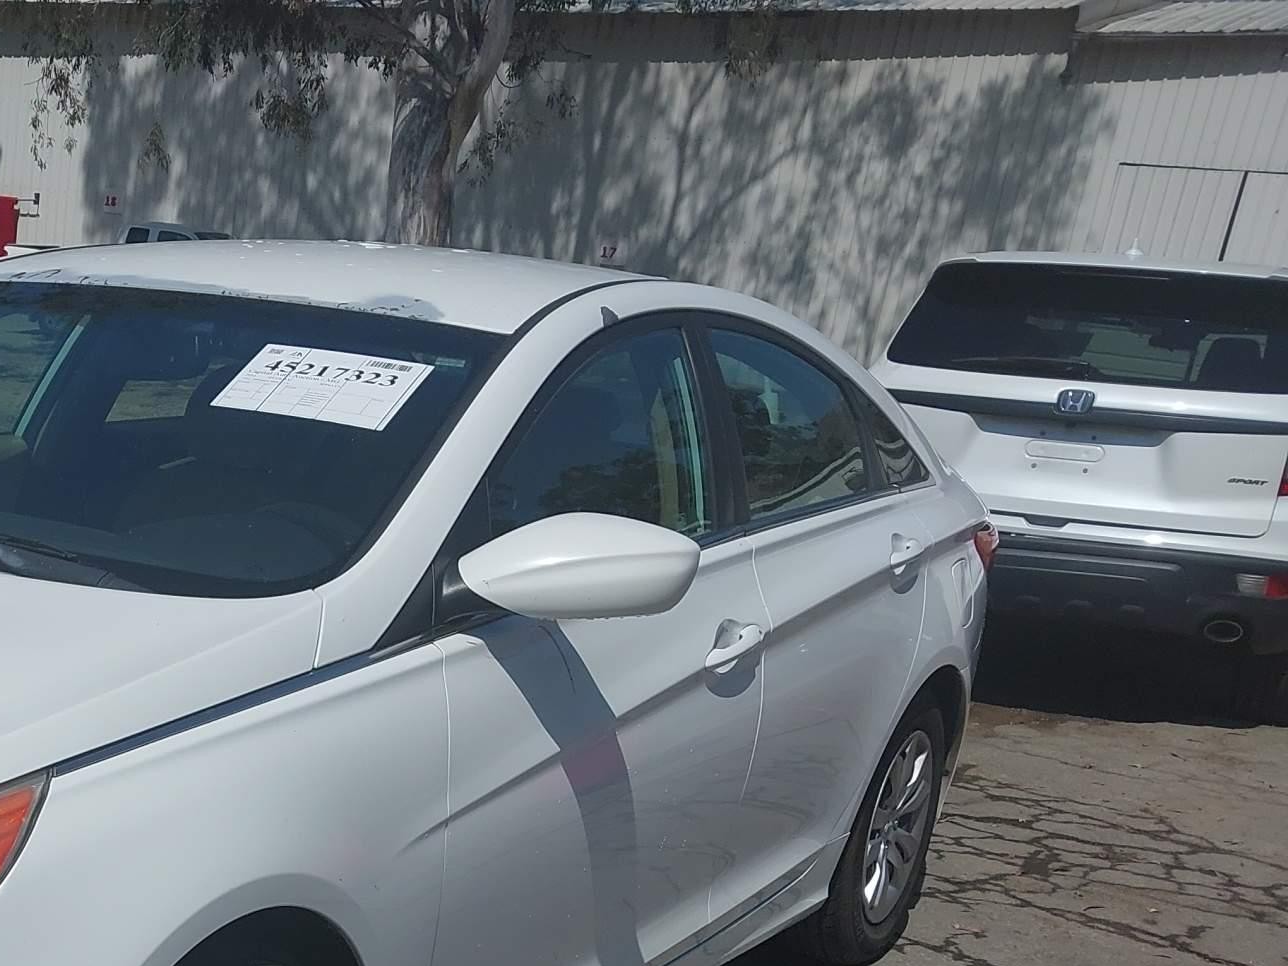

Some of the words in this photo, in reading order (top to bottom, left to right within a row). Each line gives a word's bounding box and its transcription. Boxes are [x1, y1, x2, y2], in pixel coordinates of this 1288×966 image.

[600, 246, 617, 258] 17
[265, 359, 399, 387] 45217323
[1226, 478, 1269, 486] SPORT
